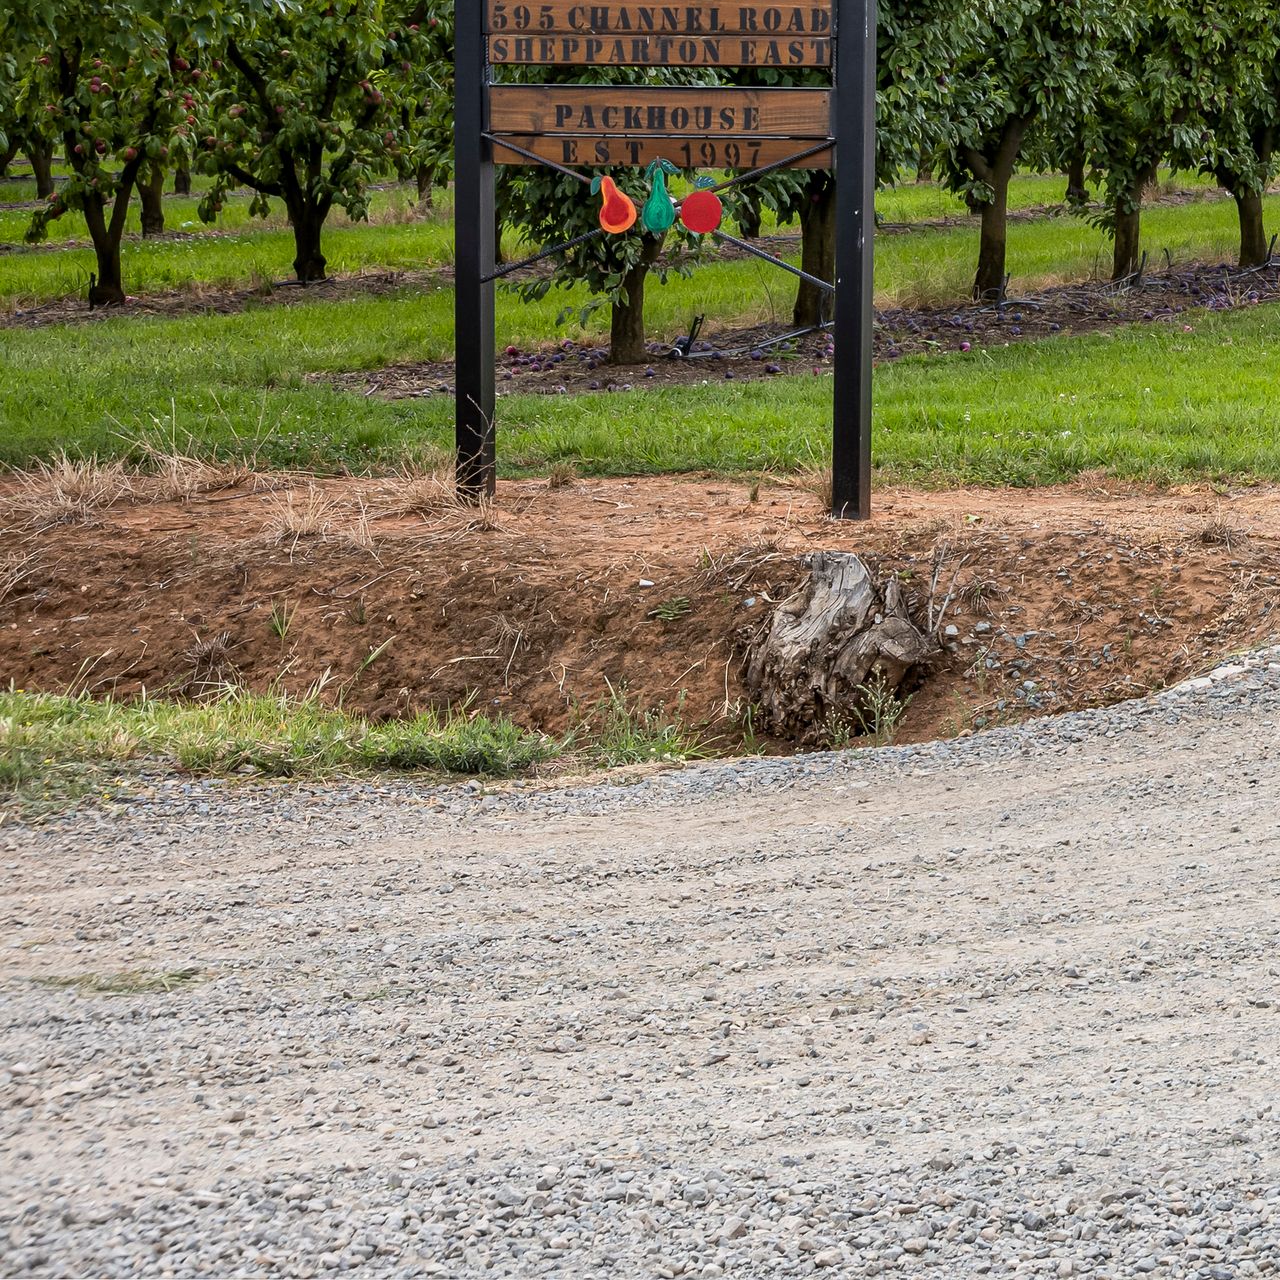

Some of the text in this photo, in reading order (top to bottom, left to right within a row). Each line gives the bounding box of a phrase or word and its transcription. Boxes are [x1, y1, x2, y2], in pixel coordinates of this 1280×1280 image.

[492, 5, 830, 33] 595 CHANNEL ROAD
[493, 38, 830, 65] SHEPPARTON EAST
[554, 104, 761, 131] PACKHOUSE
[680, 141, 763, 168] 1997
